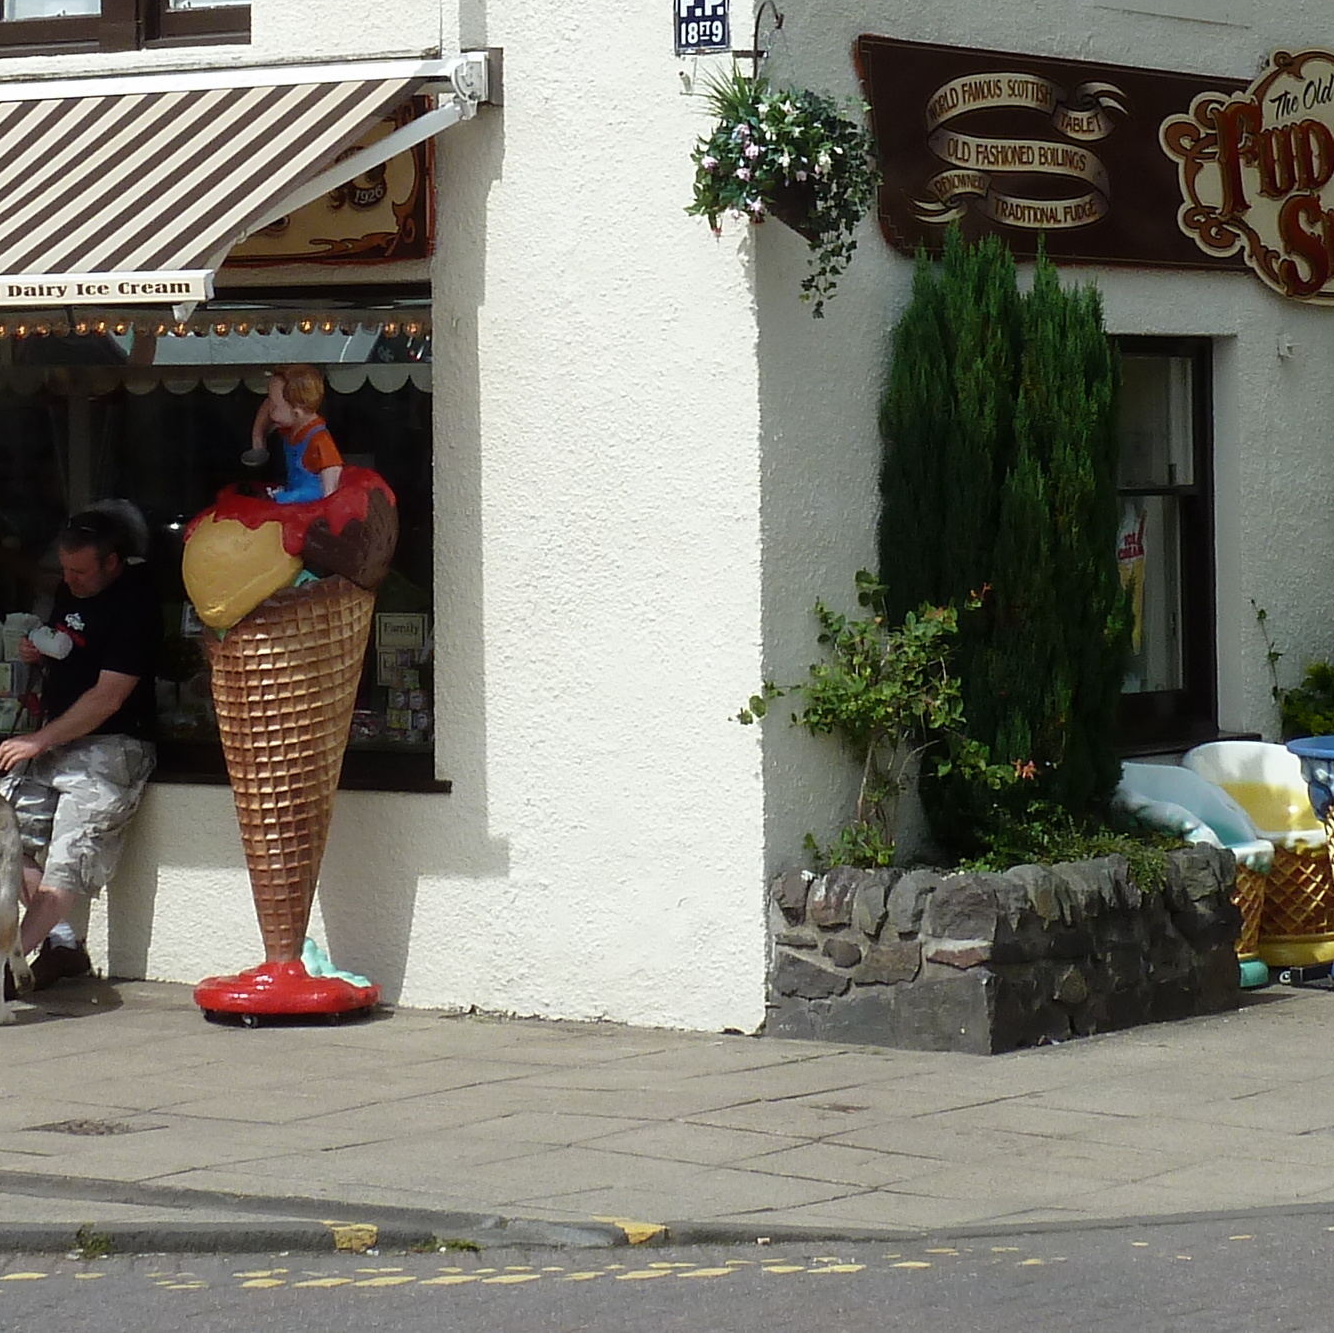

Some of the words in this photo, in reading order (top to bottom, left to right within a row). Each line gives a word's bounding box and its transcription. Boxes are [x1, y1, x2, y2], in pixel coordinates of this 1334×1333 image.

[928, 87, 959, 121] WORLD
[961, 78, 1002, 105] FAMOUS
[1007, 78, 1053, 107] SCOTTISH
[1269, 89, 1299, 122] The
[1059, 112, 1103, 134] TABLET
[947, 138, 971, 162] OLD
[975, 143, 1035, 166] FASHIONED
[353, 184, 384, 204] 1926
[934, 174, 986, 198] RENOWNED
[995, 197, 1063, 224] TRADITIONAL
[1063, 199, 1097, 223] FUDGE
[7, 283, 68, 299] Dairy
[76, 282, 110, 296] Ice
[118, 280, 192, 295] Cream
